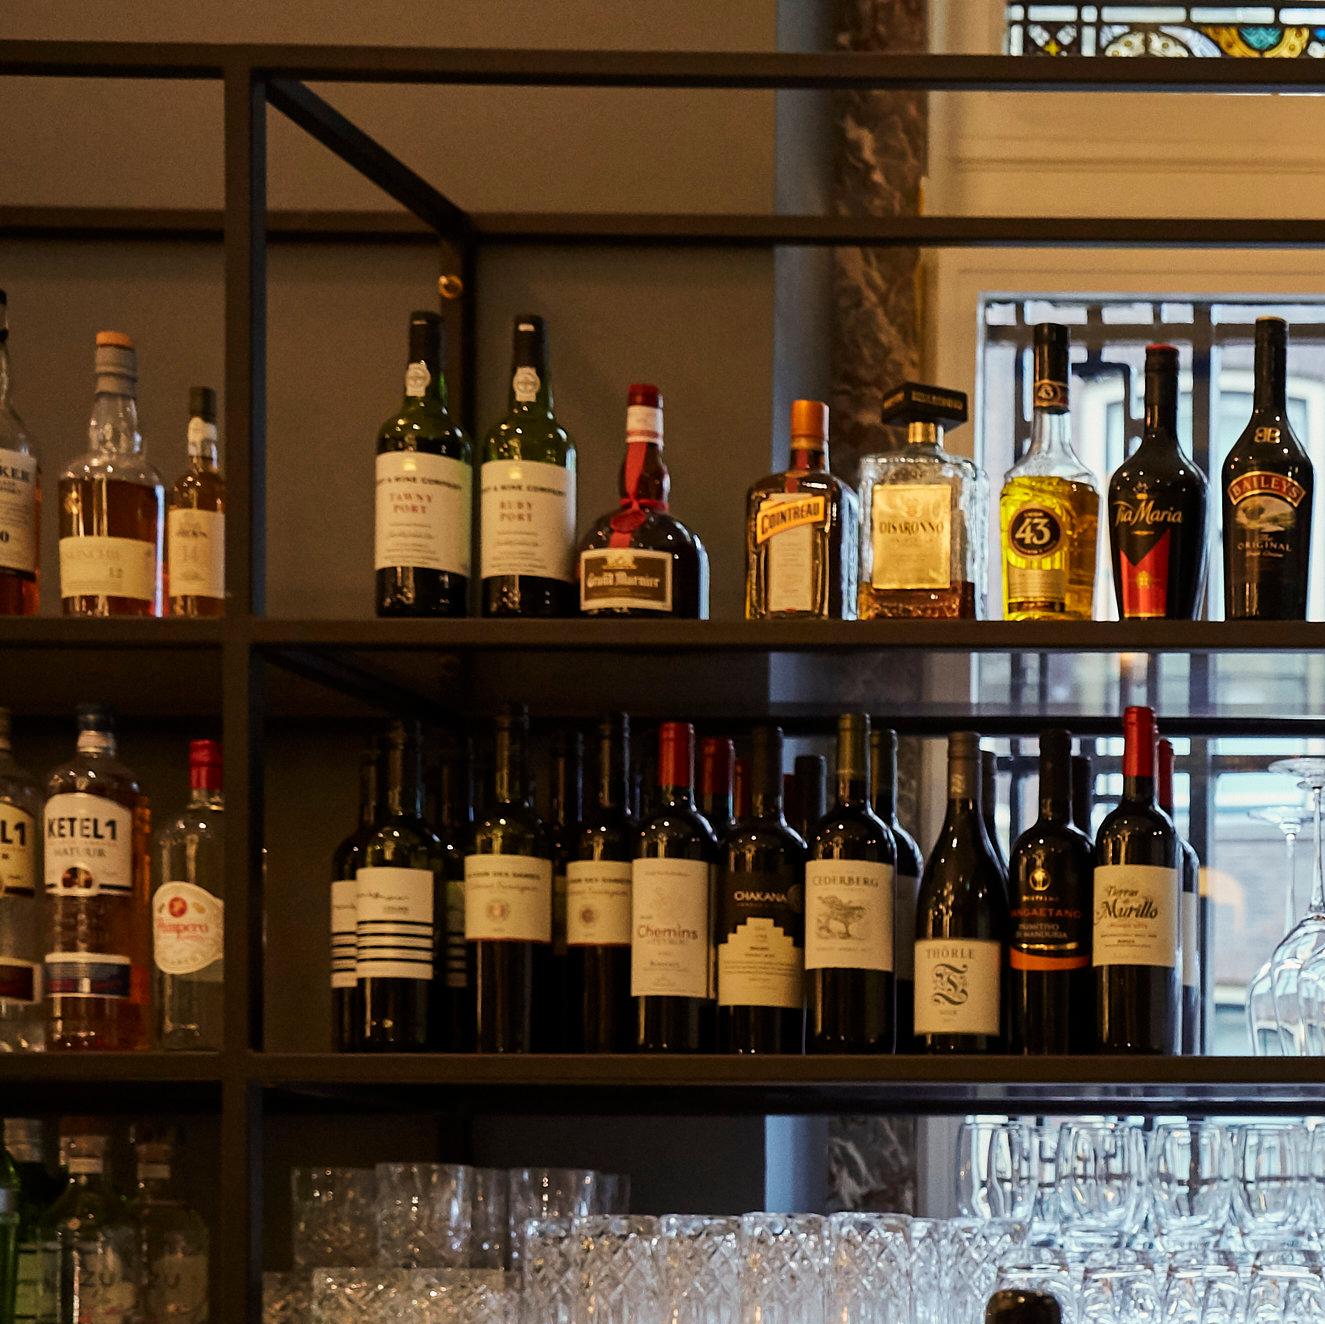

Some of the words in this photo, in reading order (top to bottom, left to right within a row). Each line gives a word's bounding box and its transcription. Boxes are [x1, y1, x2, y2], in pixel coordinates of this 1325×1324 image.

[1231, 475, 1300, 499] BAILEYS
[390, 492, 432, 503] TAWNY
[393, 505, 427, 514] PORT
[1113, 501, 1134, 527] Tia
[1130, 500, 1182, 526] Maria
[499, 512, 532, 522] PORT
[761, 502, 820, 535] COINTREAU
[879, 521, 944, 536] DISARONNO
[1015, 518, 1051, 545] 43
[1237, 541, 1292, 552] ORIGINAL
[813, 875, 879, 888] CEDERBERG
[734, 890, 788, 903] CHAKANA
[1101, 897, 1158, 919] Murillo
